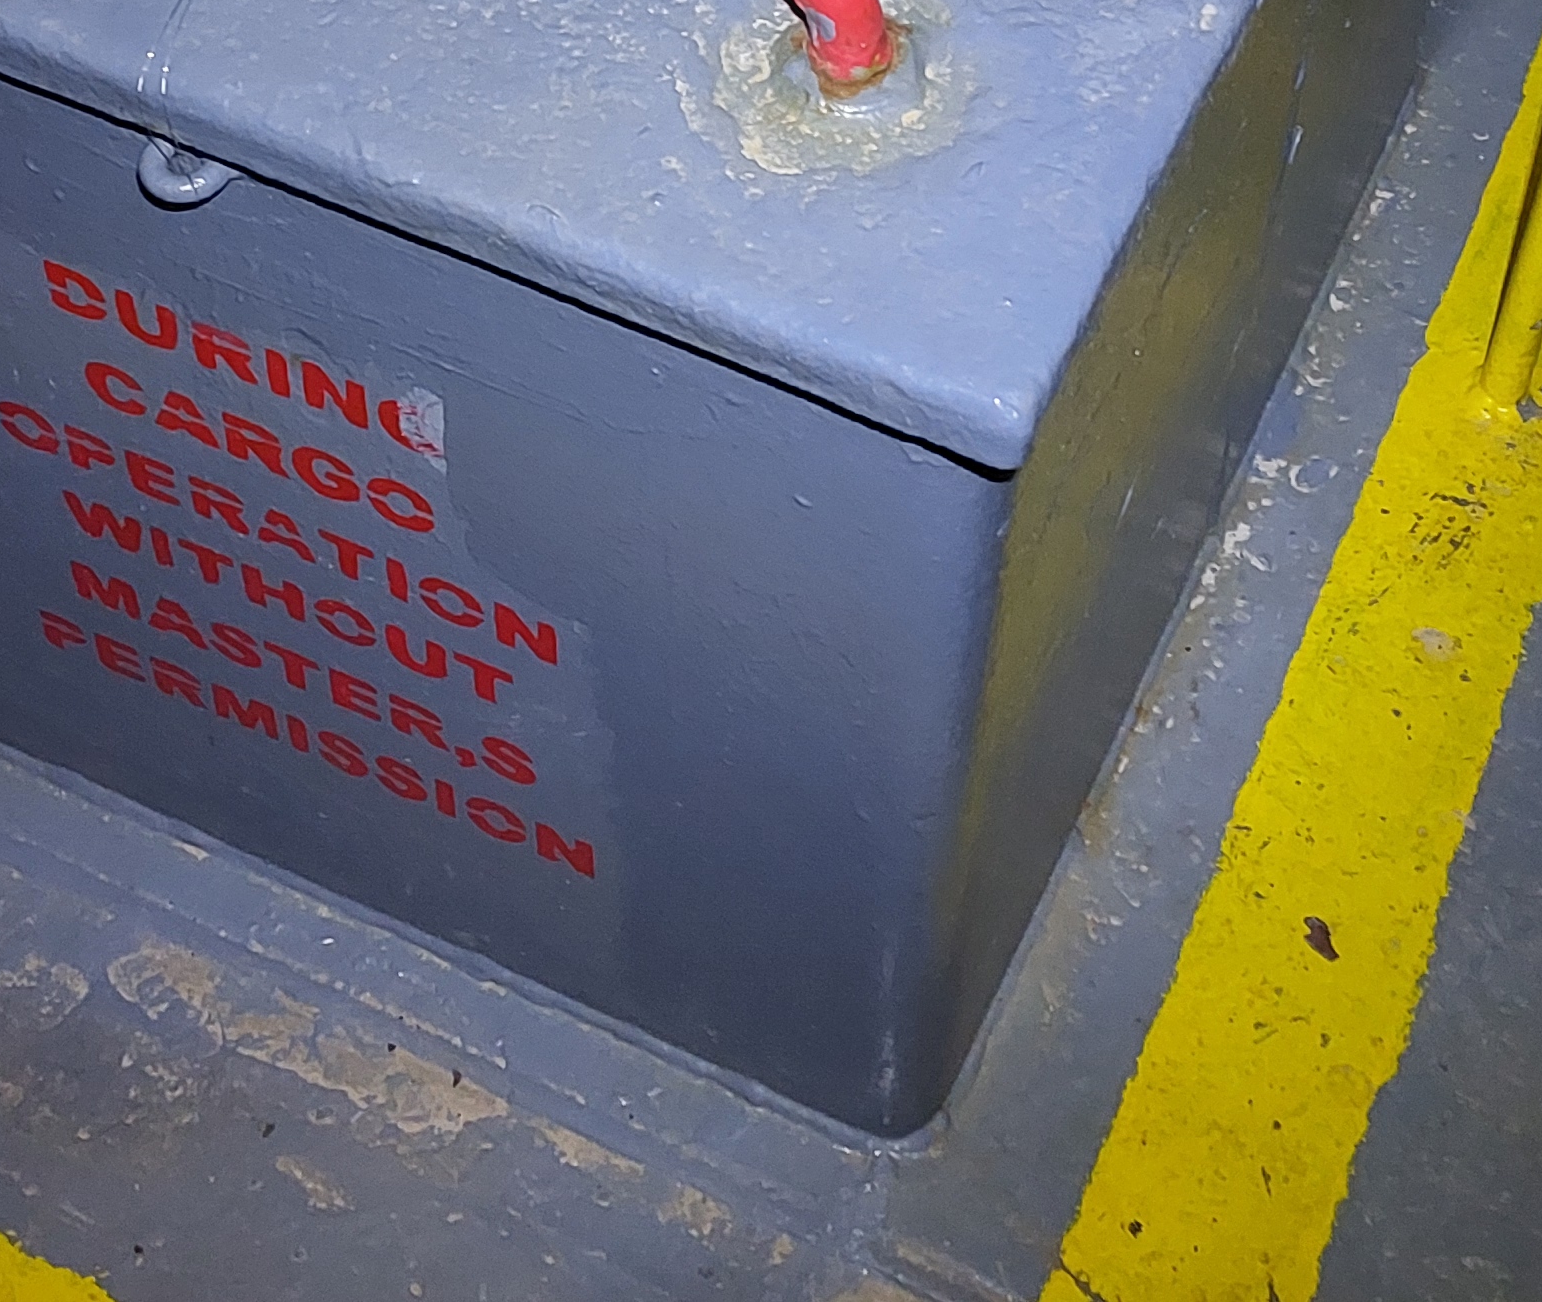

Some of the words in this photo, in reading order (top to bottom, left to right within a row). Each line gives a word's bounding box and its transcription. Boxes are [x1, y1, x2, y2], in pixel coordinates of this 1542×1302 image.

[84, 361, 435, 533] CARGO
[61, 489, 514, 704] WITHOUT
[70, 560, 537, 785] MASTER,S
[39, 609, 596, 879] PERMISSION
